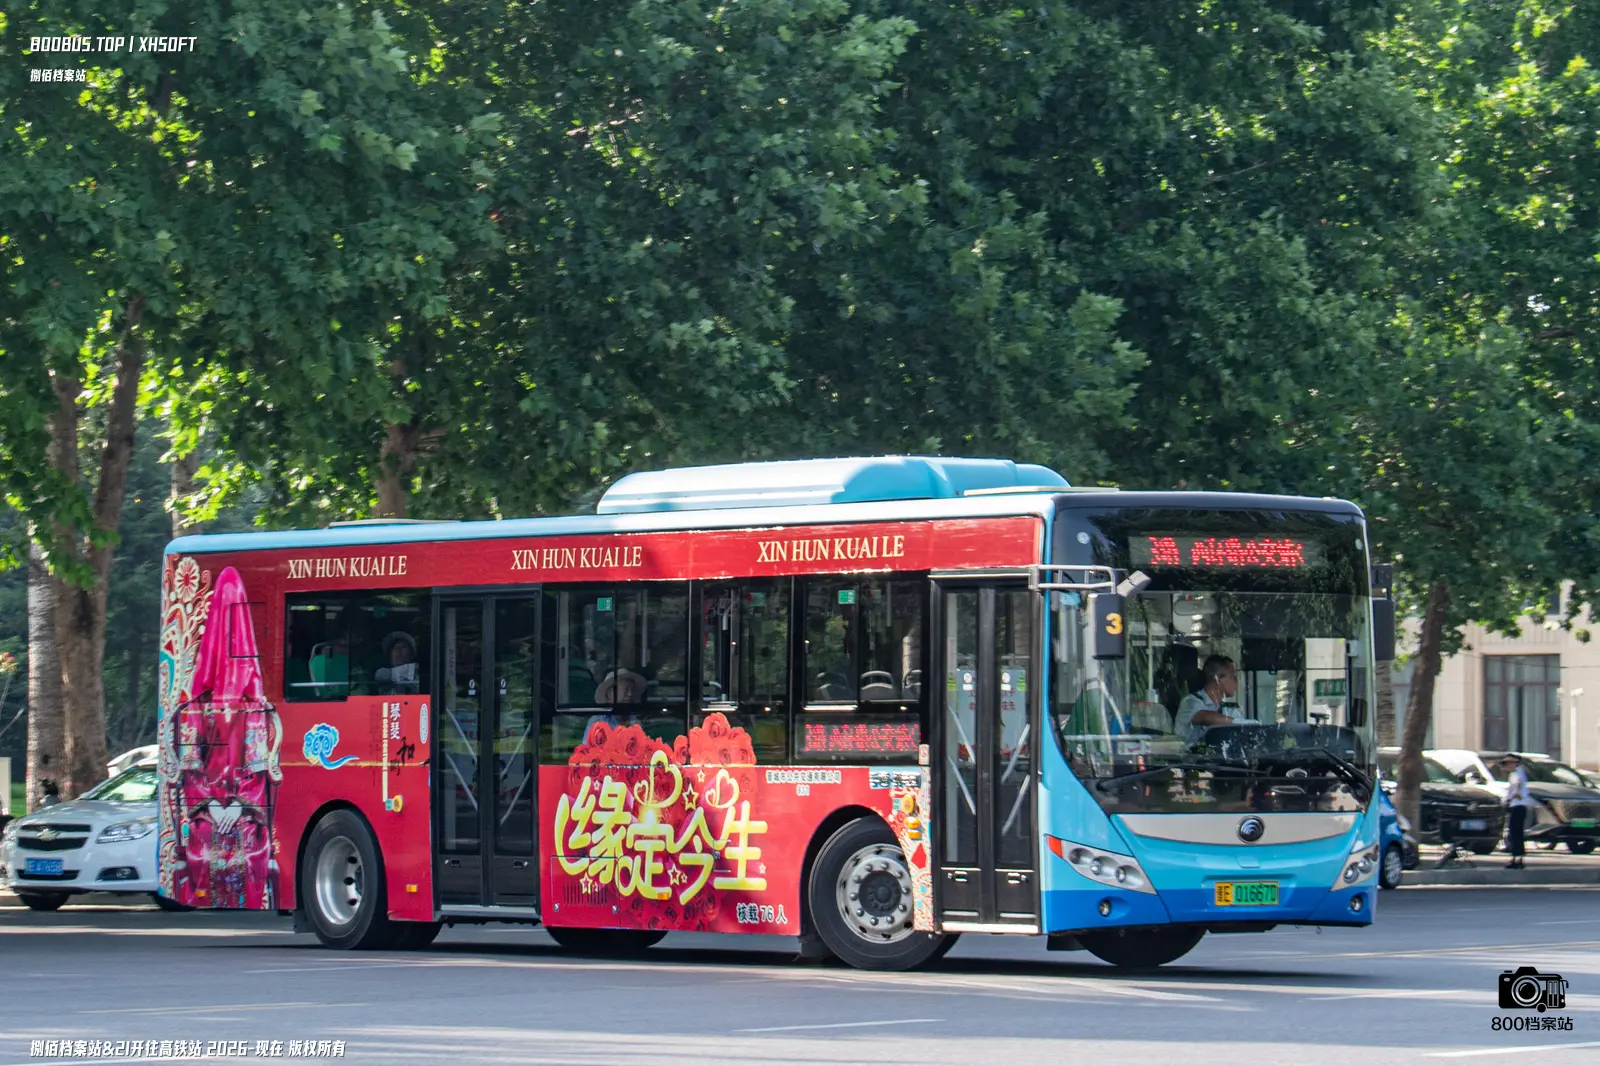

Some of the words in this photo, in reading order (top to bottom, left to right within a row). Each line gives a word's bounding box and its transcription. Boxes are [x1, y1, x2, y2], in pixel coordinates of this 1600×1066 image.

[511, 549, 540, 570] XIN
[542, 548, 576, 568] HUN
[579, 547, 620, 568] KUAI
[623, 546, 642, 566] LE
[757, 541, 788, 563] XIN
[791, 539, 831, 561] HUN
[833, 536, 879, 559] KUAI
[882, 535, 905, 557] LE
[287, 559, 313, 579] XIN
[315, 558, 347, 577] HUN
[350, 557, 387, 576] KUAI
[388, 555, 407, 575] LE
[1105, 612, 1123, 635] 3
[554, 751, 769, 905] 缘定今生
